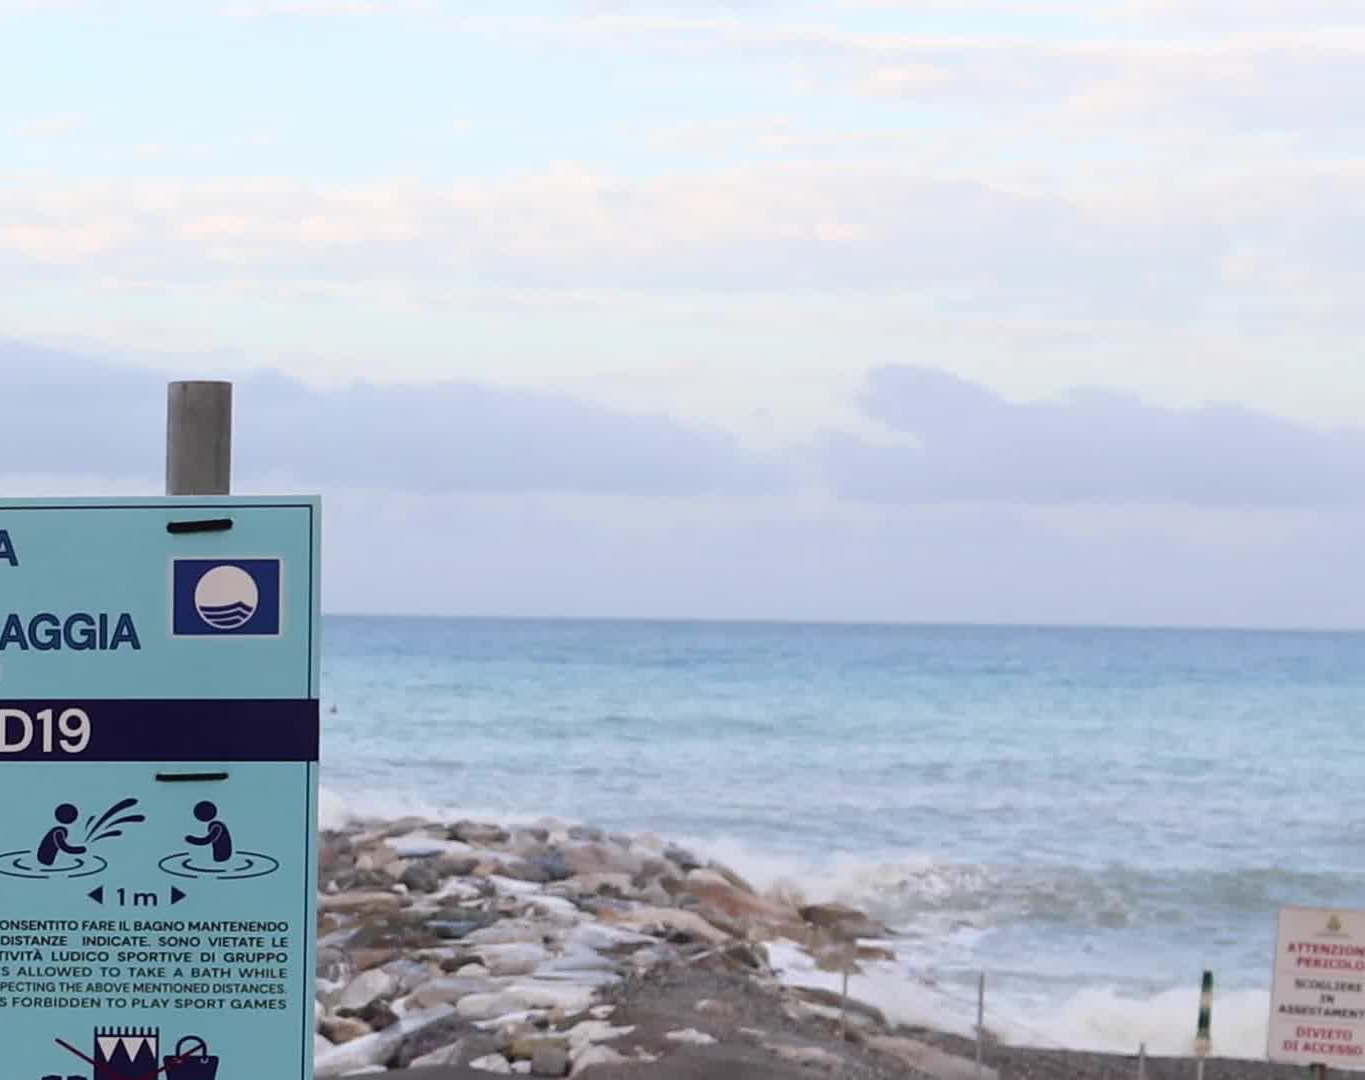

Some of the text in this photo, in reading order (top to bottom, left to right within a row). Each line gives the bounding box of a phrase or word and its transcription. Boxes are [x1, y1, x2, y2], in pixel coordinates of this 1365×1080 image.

[116, 888, 157, 906] 1 m
[81, 920, 116, 931] FARE
[118, 920, 130, 931] IL
[133, 920, 185, 931] BAGNO
[187, 920, 289, 931] MANTENENDO
[11, 996, 101, 1007] FORBIDDEN
[105, 997, 127, 1008] TO
[130, 997, 170, 1008] PLAY
[173, 997, 225, 1008] SPORT
[229, 998, 287, 1009] GAMES
